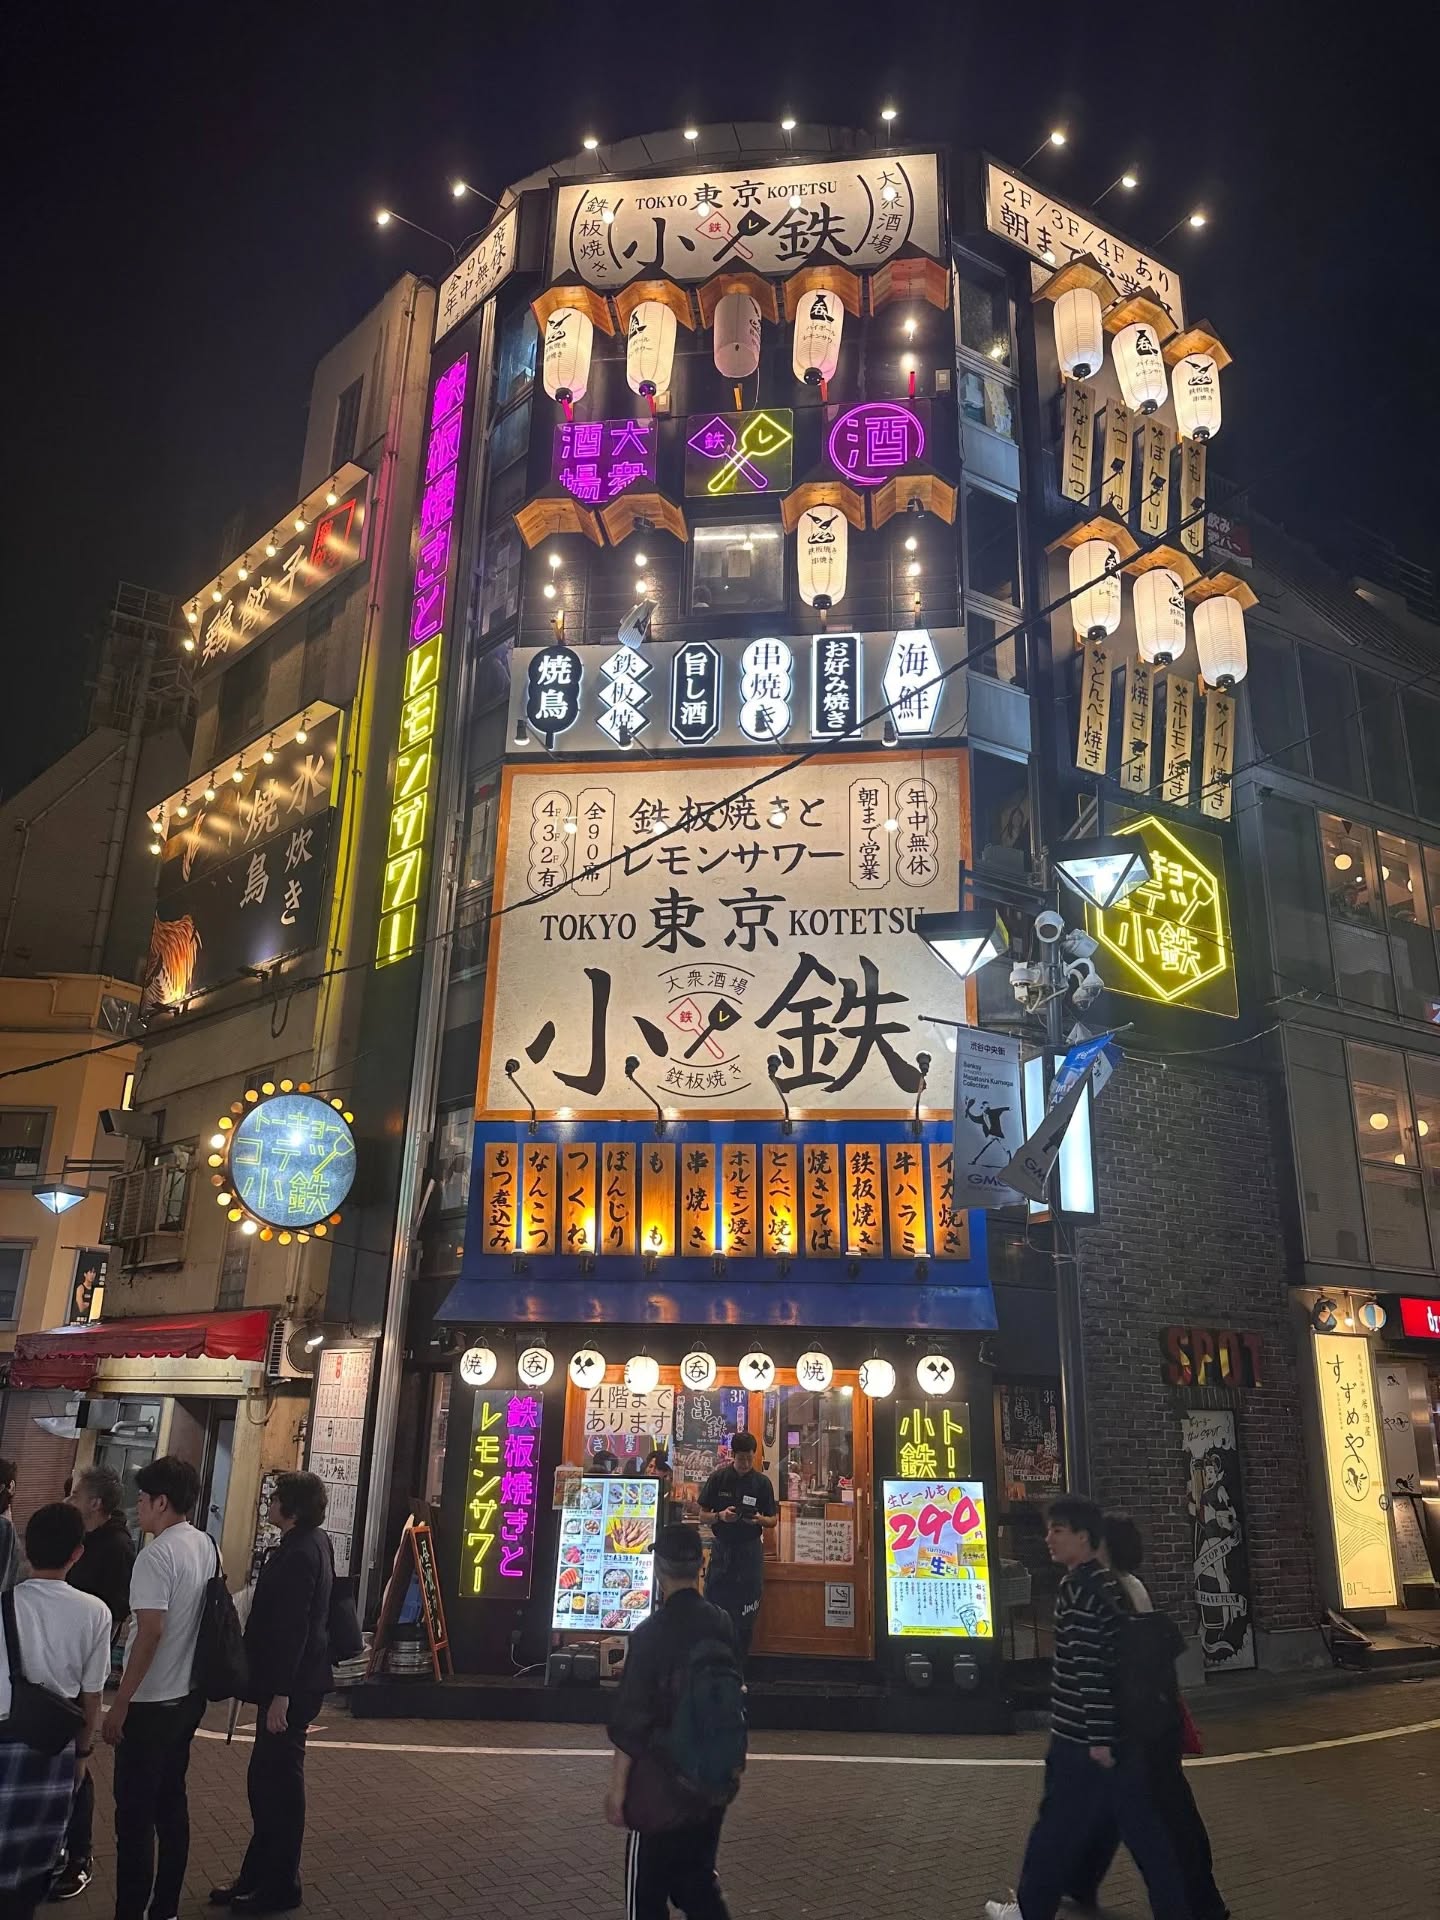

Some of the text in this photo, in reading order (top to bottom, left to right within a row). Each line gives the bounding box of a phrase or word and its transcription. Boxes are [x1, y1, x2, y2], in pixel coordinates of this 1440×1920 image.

[635, 179, 839, 211] TOKYO 東京 KOTETSU
[578, 196, 609, 278] 鉄板焼き
[704, 433, 725, 450] 鉄
[846, 415, 909, 469] 酒
[1068, 406, 1088, 496] なんこつ
[535, 654, 573, 720] 焼鳥
[609, 653, 637, 731] 鉄板焼
[680, 652, 708, 725] 旨し酒
[823, 641, 850, 729] お好み焼き
[896, 643, 929, 720] 海鮮
[1084, 667, 1105, 767] とんぺい焼き
[629, 794, 825, 835] 鉄板焼きと
[857, 786, 882, 881] 朝まで営業
[906, 787, 932, 876] 年中無休
[623, 841, 845, 877] レモンサワー
[540, 886, 926, 954] TOKYO 東京 KOTETSU
[1118, 912, 1202, 979] 小鉄
[665, 969, 749, 997] 大衆酒場
[679, 1011, 693, 1024] 鉄
[970, 1041, 1006, 1056] 渋谷中央街
[664, 1062, 744, 1092] 鉄板焼き
[255, 1105, 342, 1140] トーキョー
[241, 1167, 331, 1216] 小鉄
[489, 1149, 513, 1248] もつ煮込み
[528, 1151, 550, 1248] なんこつ
[567, 1151, 589, 1246] つくね
[606, 1150, 629, 1248] ぼんじり
[649, 1151, 664, 1247] もも
[685, 1149, 710, 1249] 串焼き
[728, 1150, 751, 1252] ホルモン焼き
[767, 1151, 792, 1252] とんぺい焼き
[807, 1149, 833, 1253] 焼きそば
[850, 1151, 877, 1254] 鉄板焼き
[892, 1151, 918, 1254] 牛ハラミ
[462, 1353, 483, 1376] 焼
[527, 1355, 543, 1374] 呑
[689, 1360, 705, 1378] 呑
[803, 1360, 825, 1382] 焼
[1168, 1327, 1264, 1387] SPOT
[586, 1409, 671, 1434] あります
[589, 1385, 672, 1410] 4階まで
[730, 1389, 746, 1404] 3F
[1326, 1353, 1365, 1464] すずめや
[899, 1408, 938, 1479] 小鉄
[467, 1401, 503, 1593] レモンサワー
[498, 1395, 538, 1577] 鉄板焼きと
[887, 1484, 948, 1510] 生ビールも
[888, 1495, 981, 1552] 290
[1200, 1542, 1230, 1568] STOP BY
[1200, 1593, 1219, 1603] HAVE
